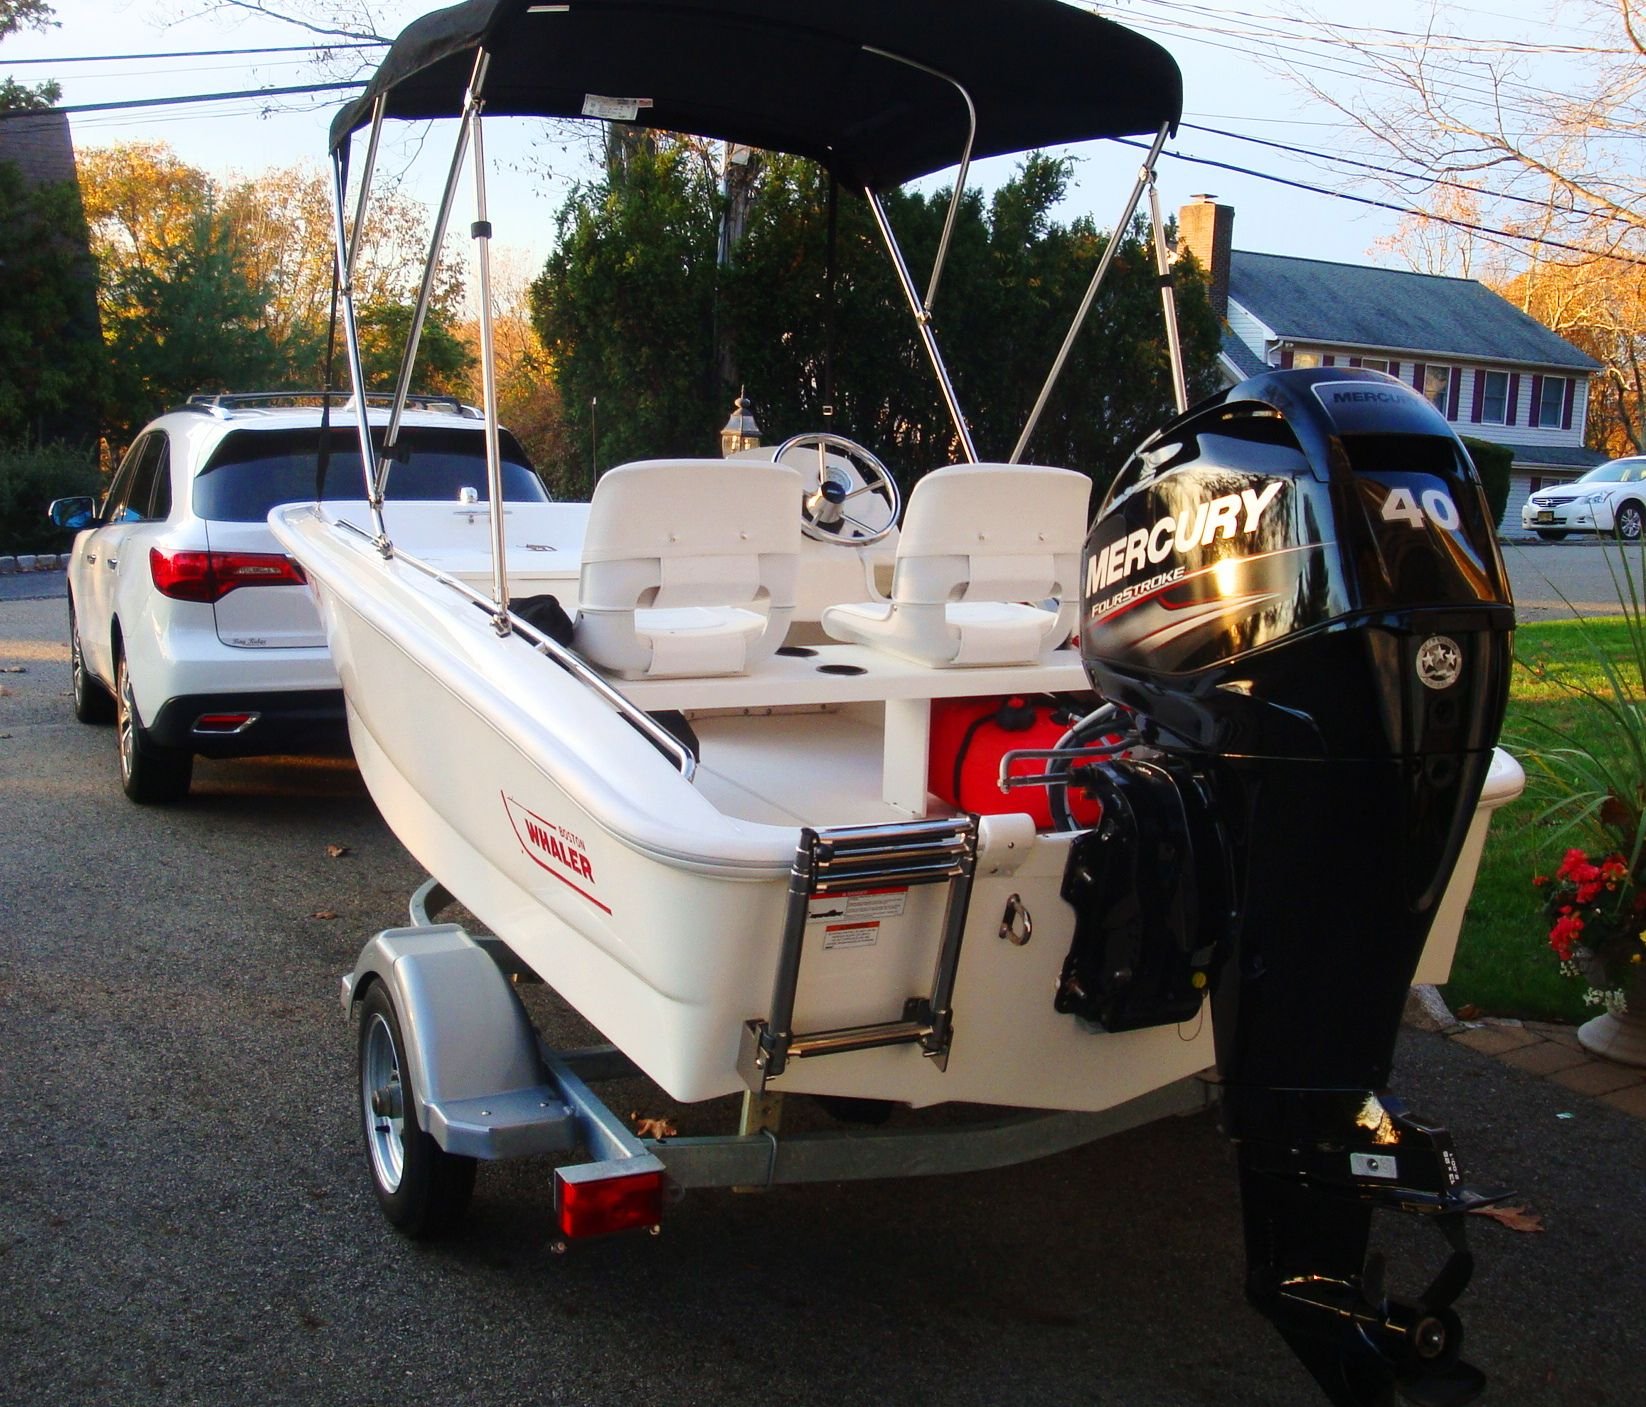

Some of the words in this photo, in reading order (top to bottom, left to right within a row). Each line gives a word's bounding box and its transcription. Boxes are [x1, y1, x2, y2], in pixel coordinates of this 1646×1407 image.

[1381, 488, 1460, 531] 40
[1085, 482, 1283, 599] MERCURY
[525, 818, 595, 885] WHALER
[559, 826, 586, 851] BOSTON
